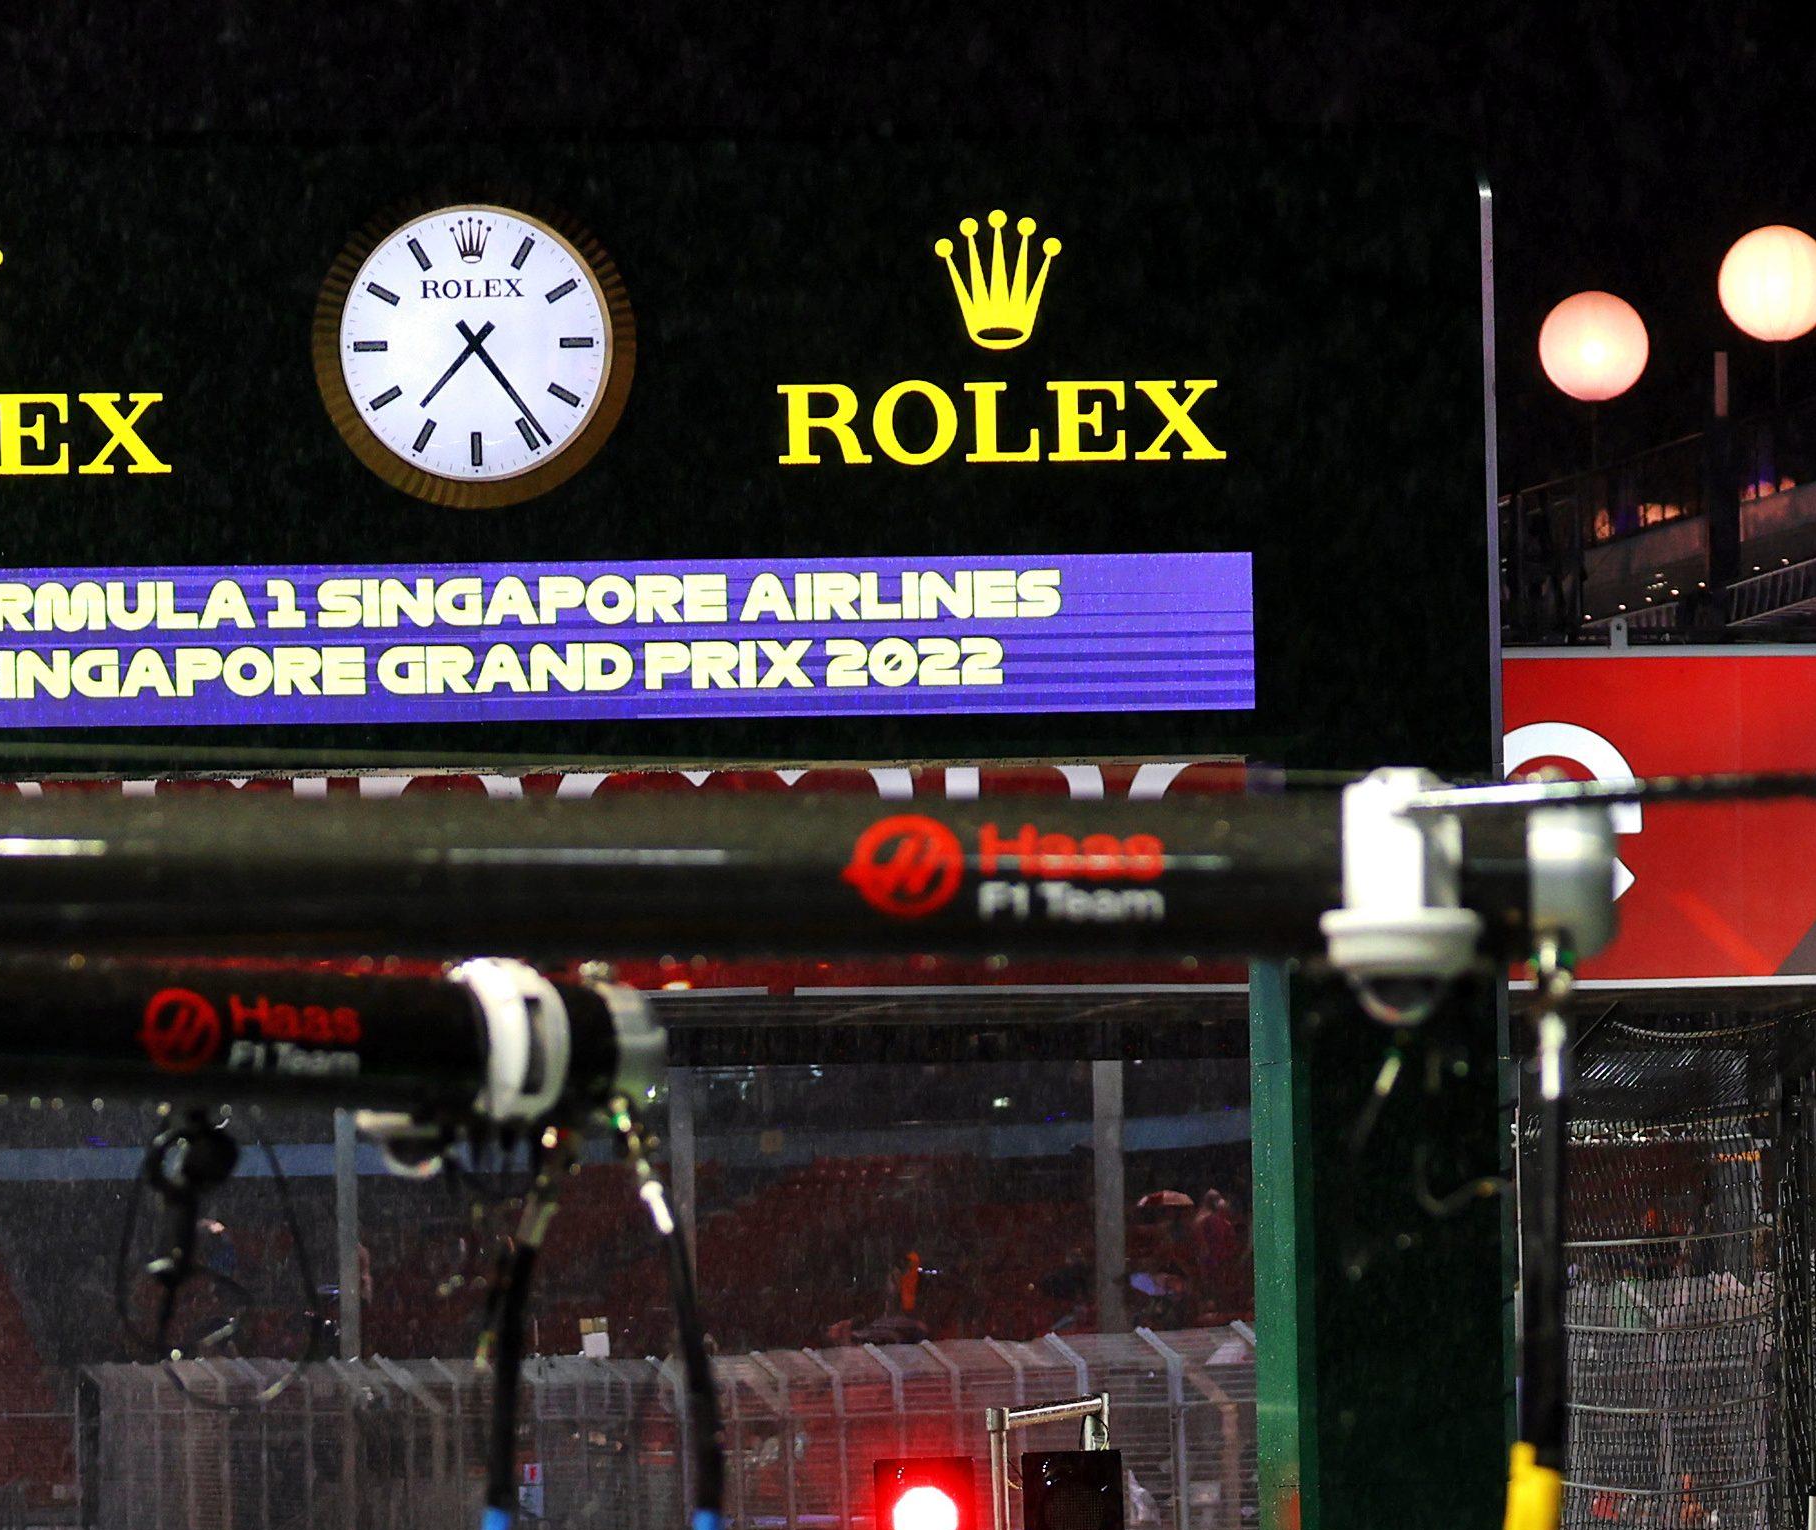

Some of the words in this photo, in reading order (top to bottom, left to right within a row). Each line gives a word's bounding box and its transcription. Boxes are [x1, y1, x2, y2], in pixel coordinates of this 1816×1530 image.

[421, 278, 524, 299] ROLEX
[777, 379, 1227, 466] ROLEX
[265, 579, 307, 629] 1
[316, 573, 729, 629] SINGAPORE
[739, 568, 1062, 623] AIRLINES
[376, 642, 635, 696] GRAND
[643, 638, 815, 691] PRIX
[825, 636, 1004, 687] 2022
[979, 822, 1165, 881] Haas
[979, 880, 1030, 921] F1
[1037, 880, 1165, 923] Team
[228, 993, 362, 1043] Haas
